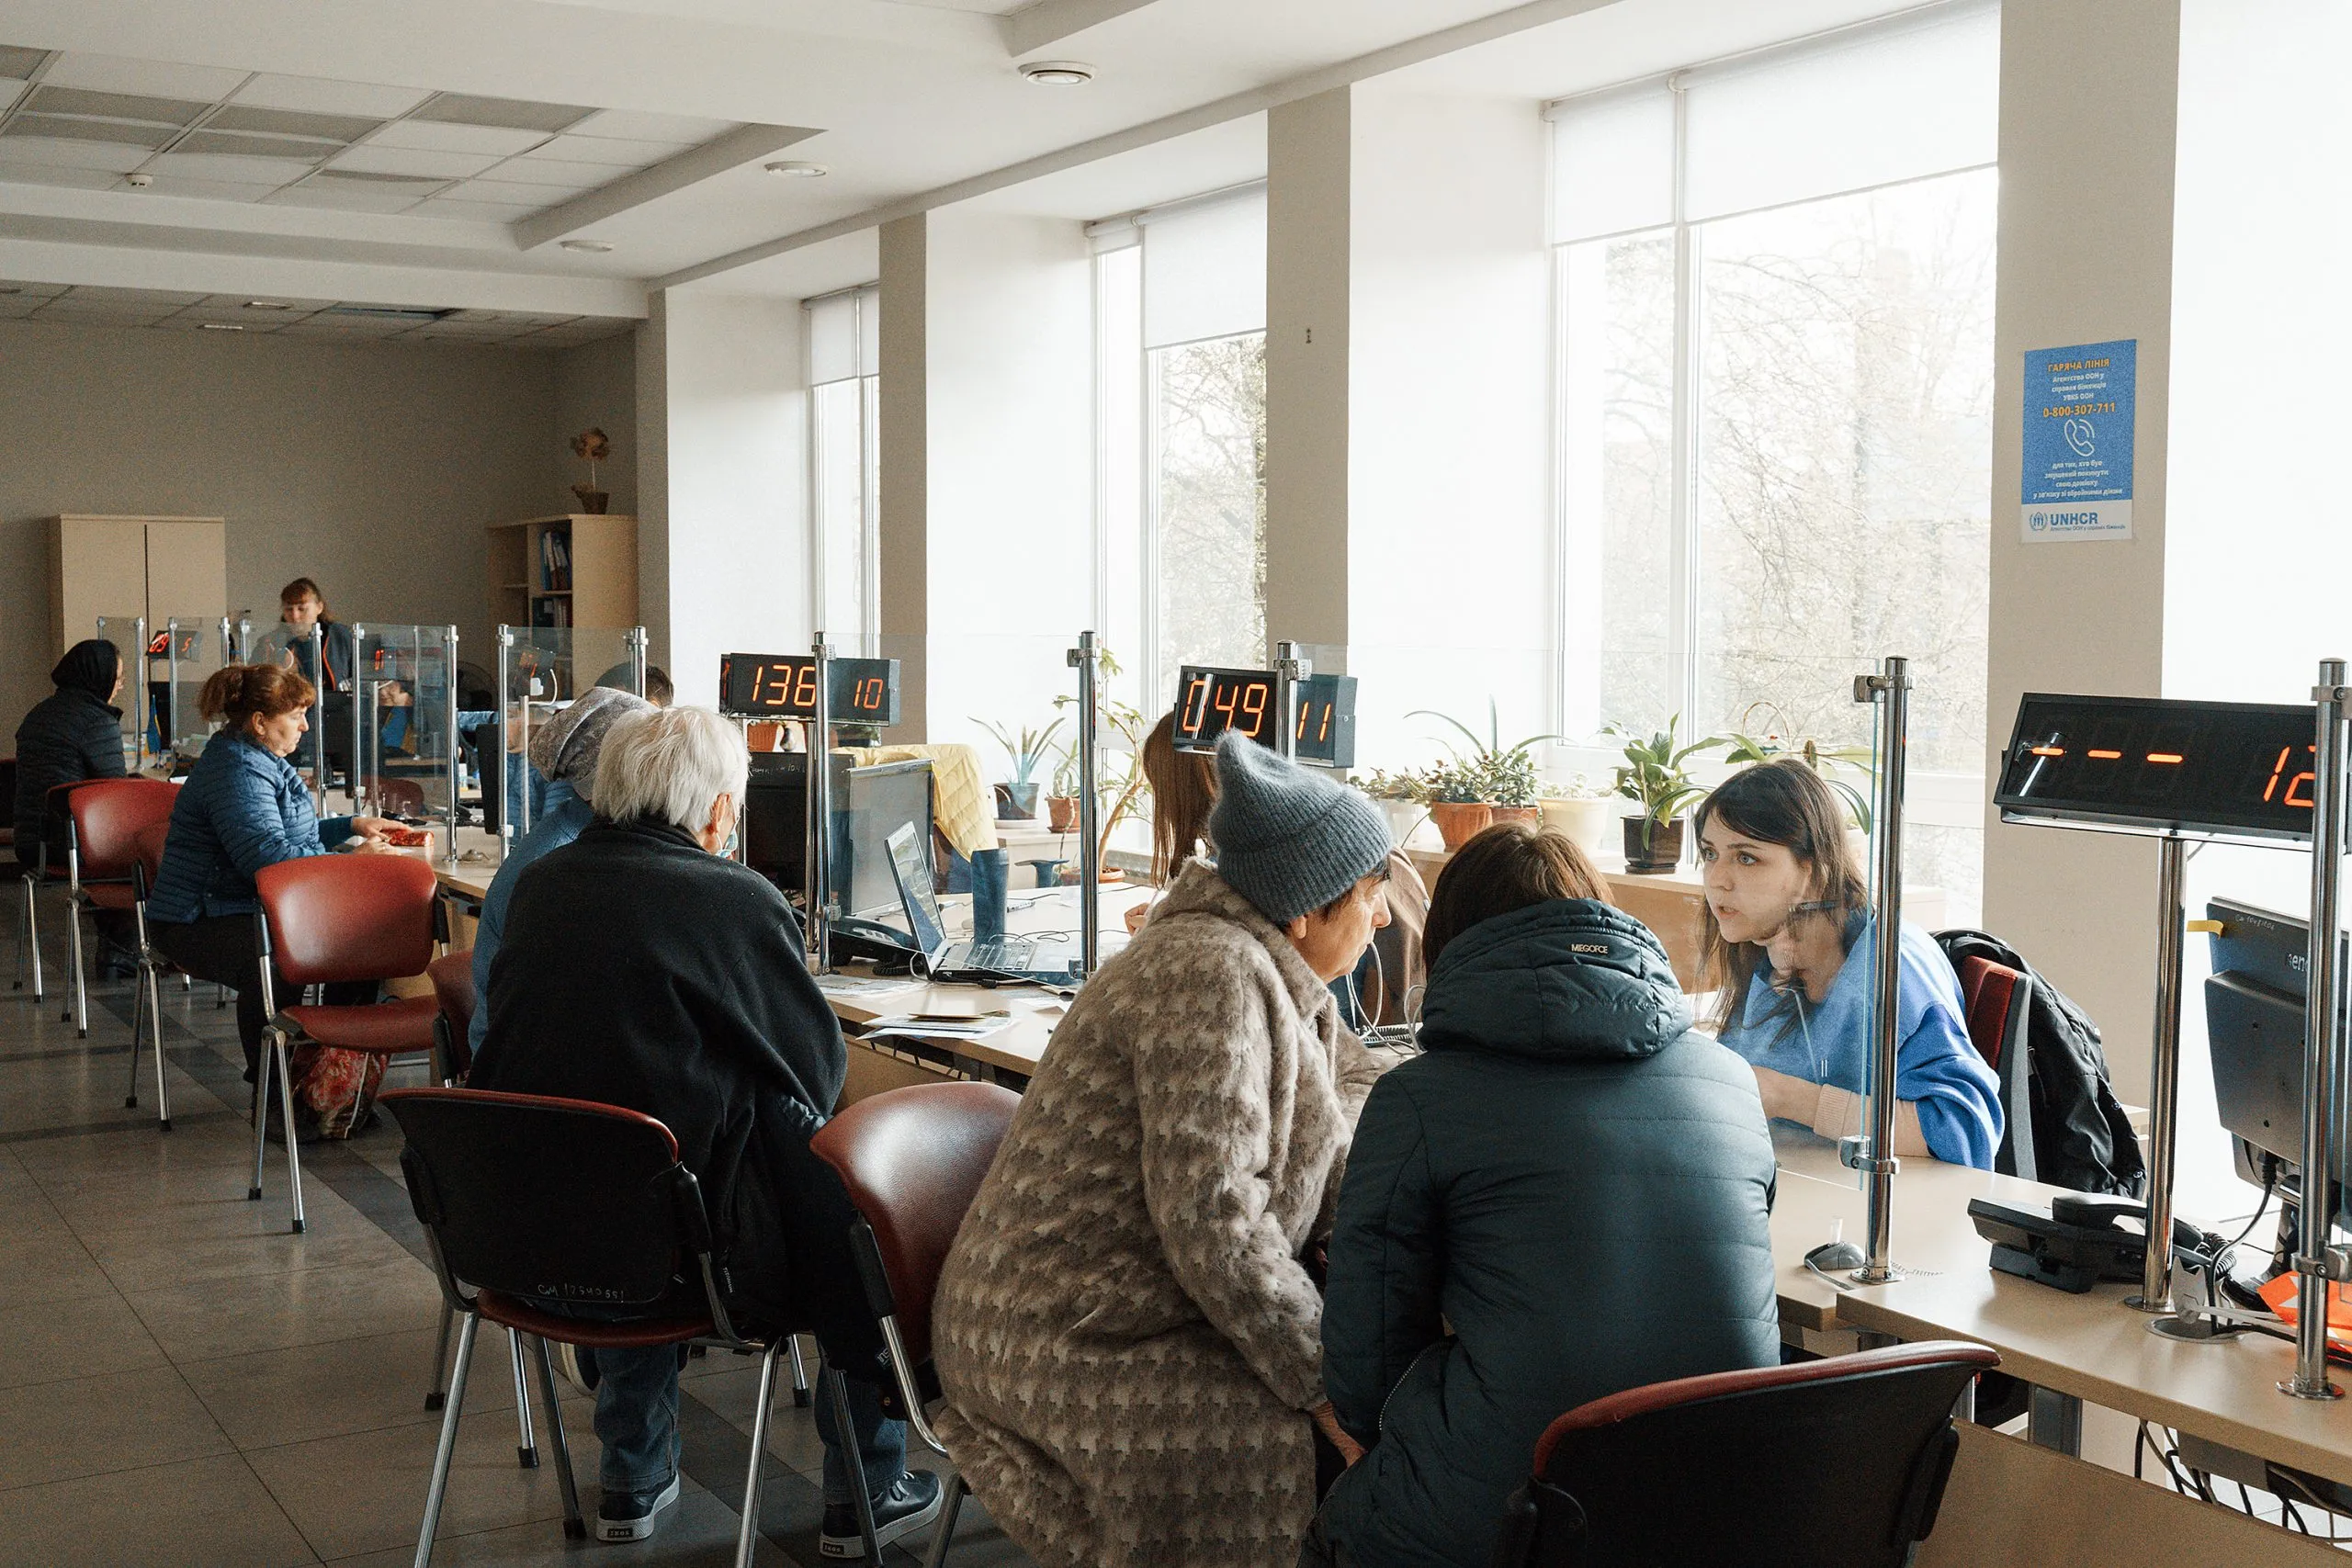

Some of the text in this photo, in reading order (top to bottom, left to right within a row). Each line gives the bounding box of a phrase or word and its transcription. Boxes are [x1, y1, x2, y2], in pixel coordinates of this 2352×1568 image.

[2048, 358, 2110, 372] ГАРЯЧА ЛІНІЯ
[2043, 401, 2116, 418] 0-800-307-711
[2050, 512, 2098, 526] UNHCR
[752, 664, 884, 710] 136 10
[1182, 680, 1331, 742] 049 11
